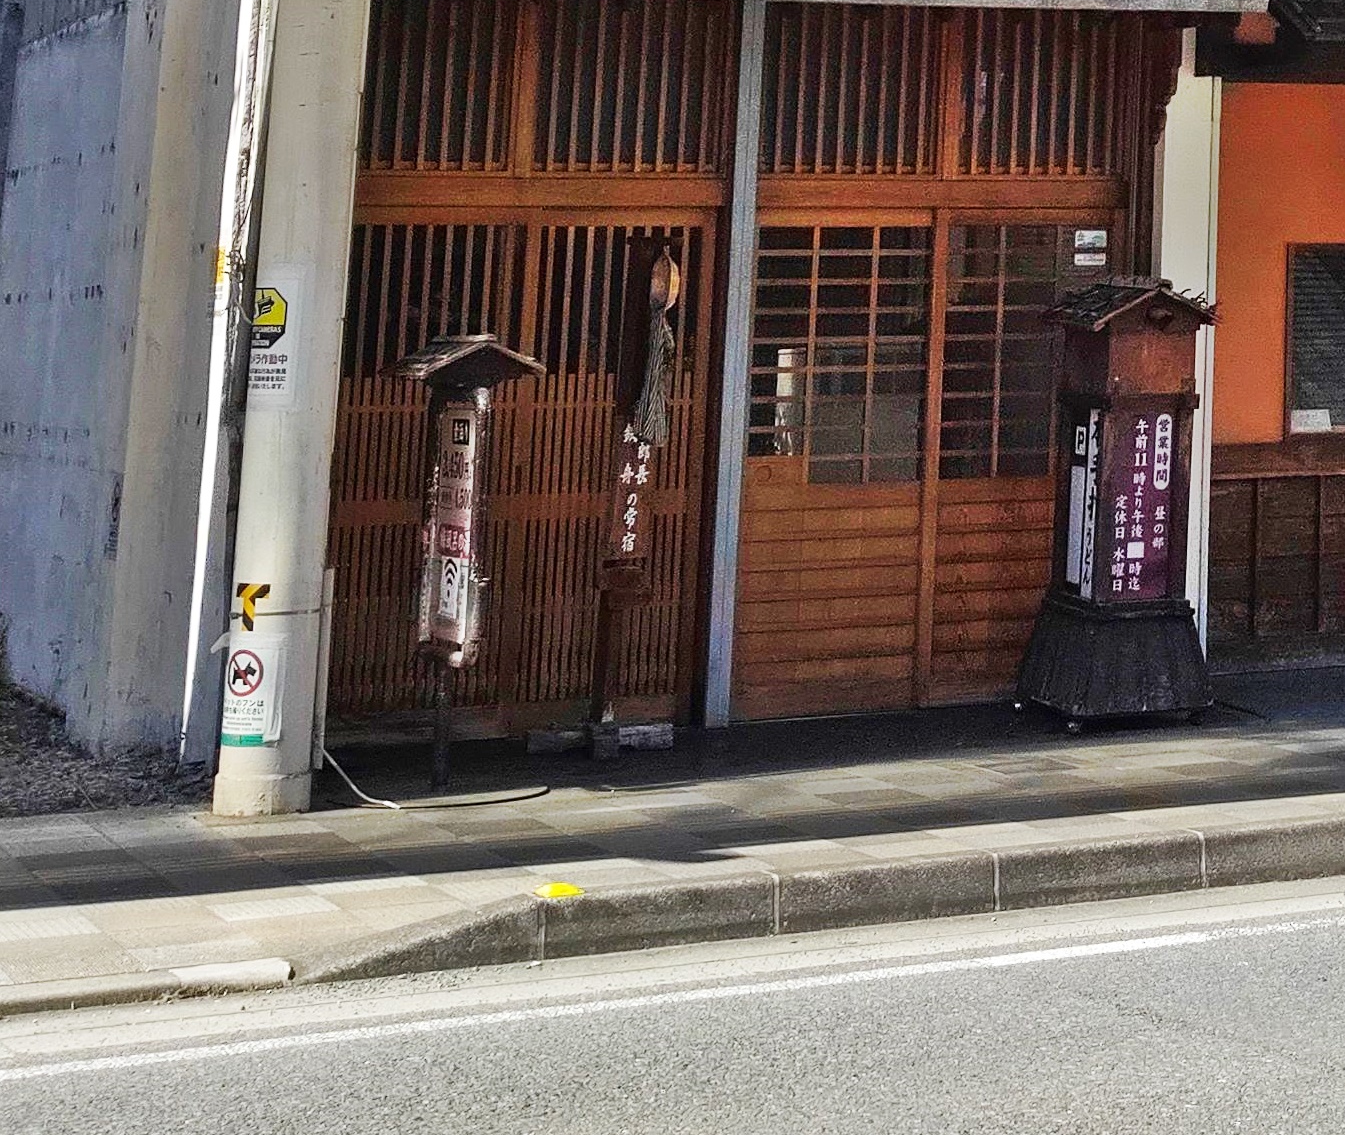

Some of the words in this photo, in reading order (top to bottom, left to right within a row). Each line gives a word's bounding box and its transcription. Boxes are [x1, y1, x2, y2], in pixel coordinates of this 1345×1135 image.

[635, 432, 651, 485] 郎長
[1155, 418, 1170, 483] 営業時間
[1114, 495, 1128, 540] 定休日
[1127, 418, 1149, 591] 午前11時より午後時迄
[1152, 505, 1166, 550] 昼の部
[1111, 546, 1126, 592] 水曜日
